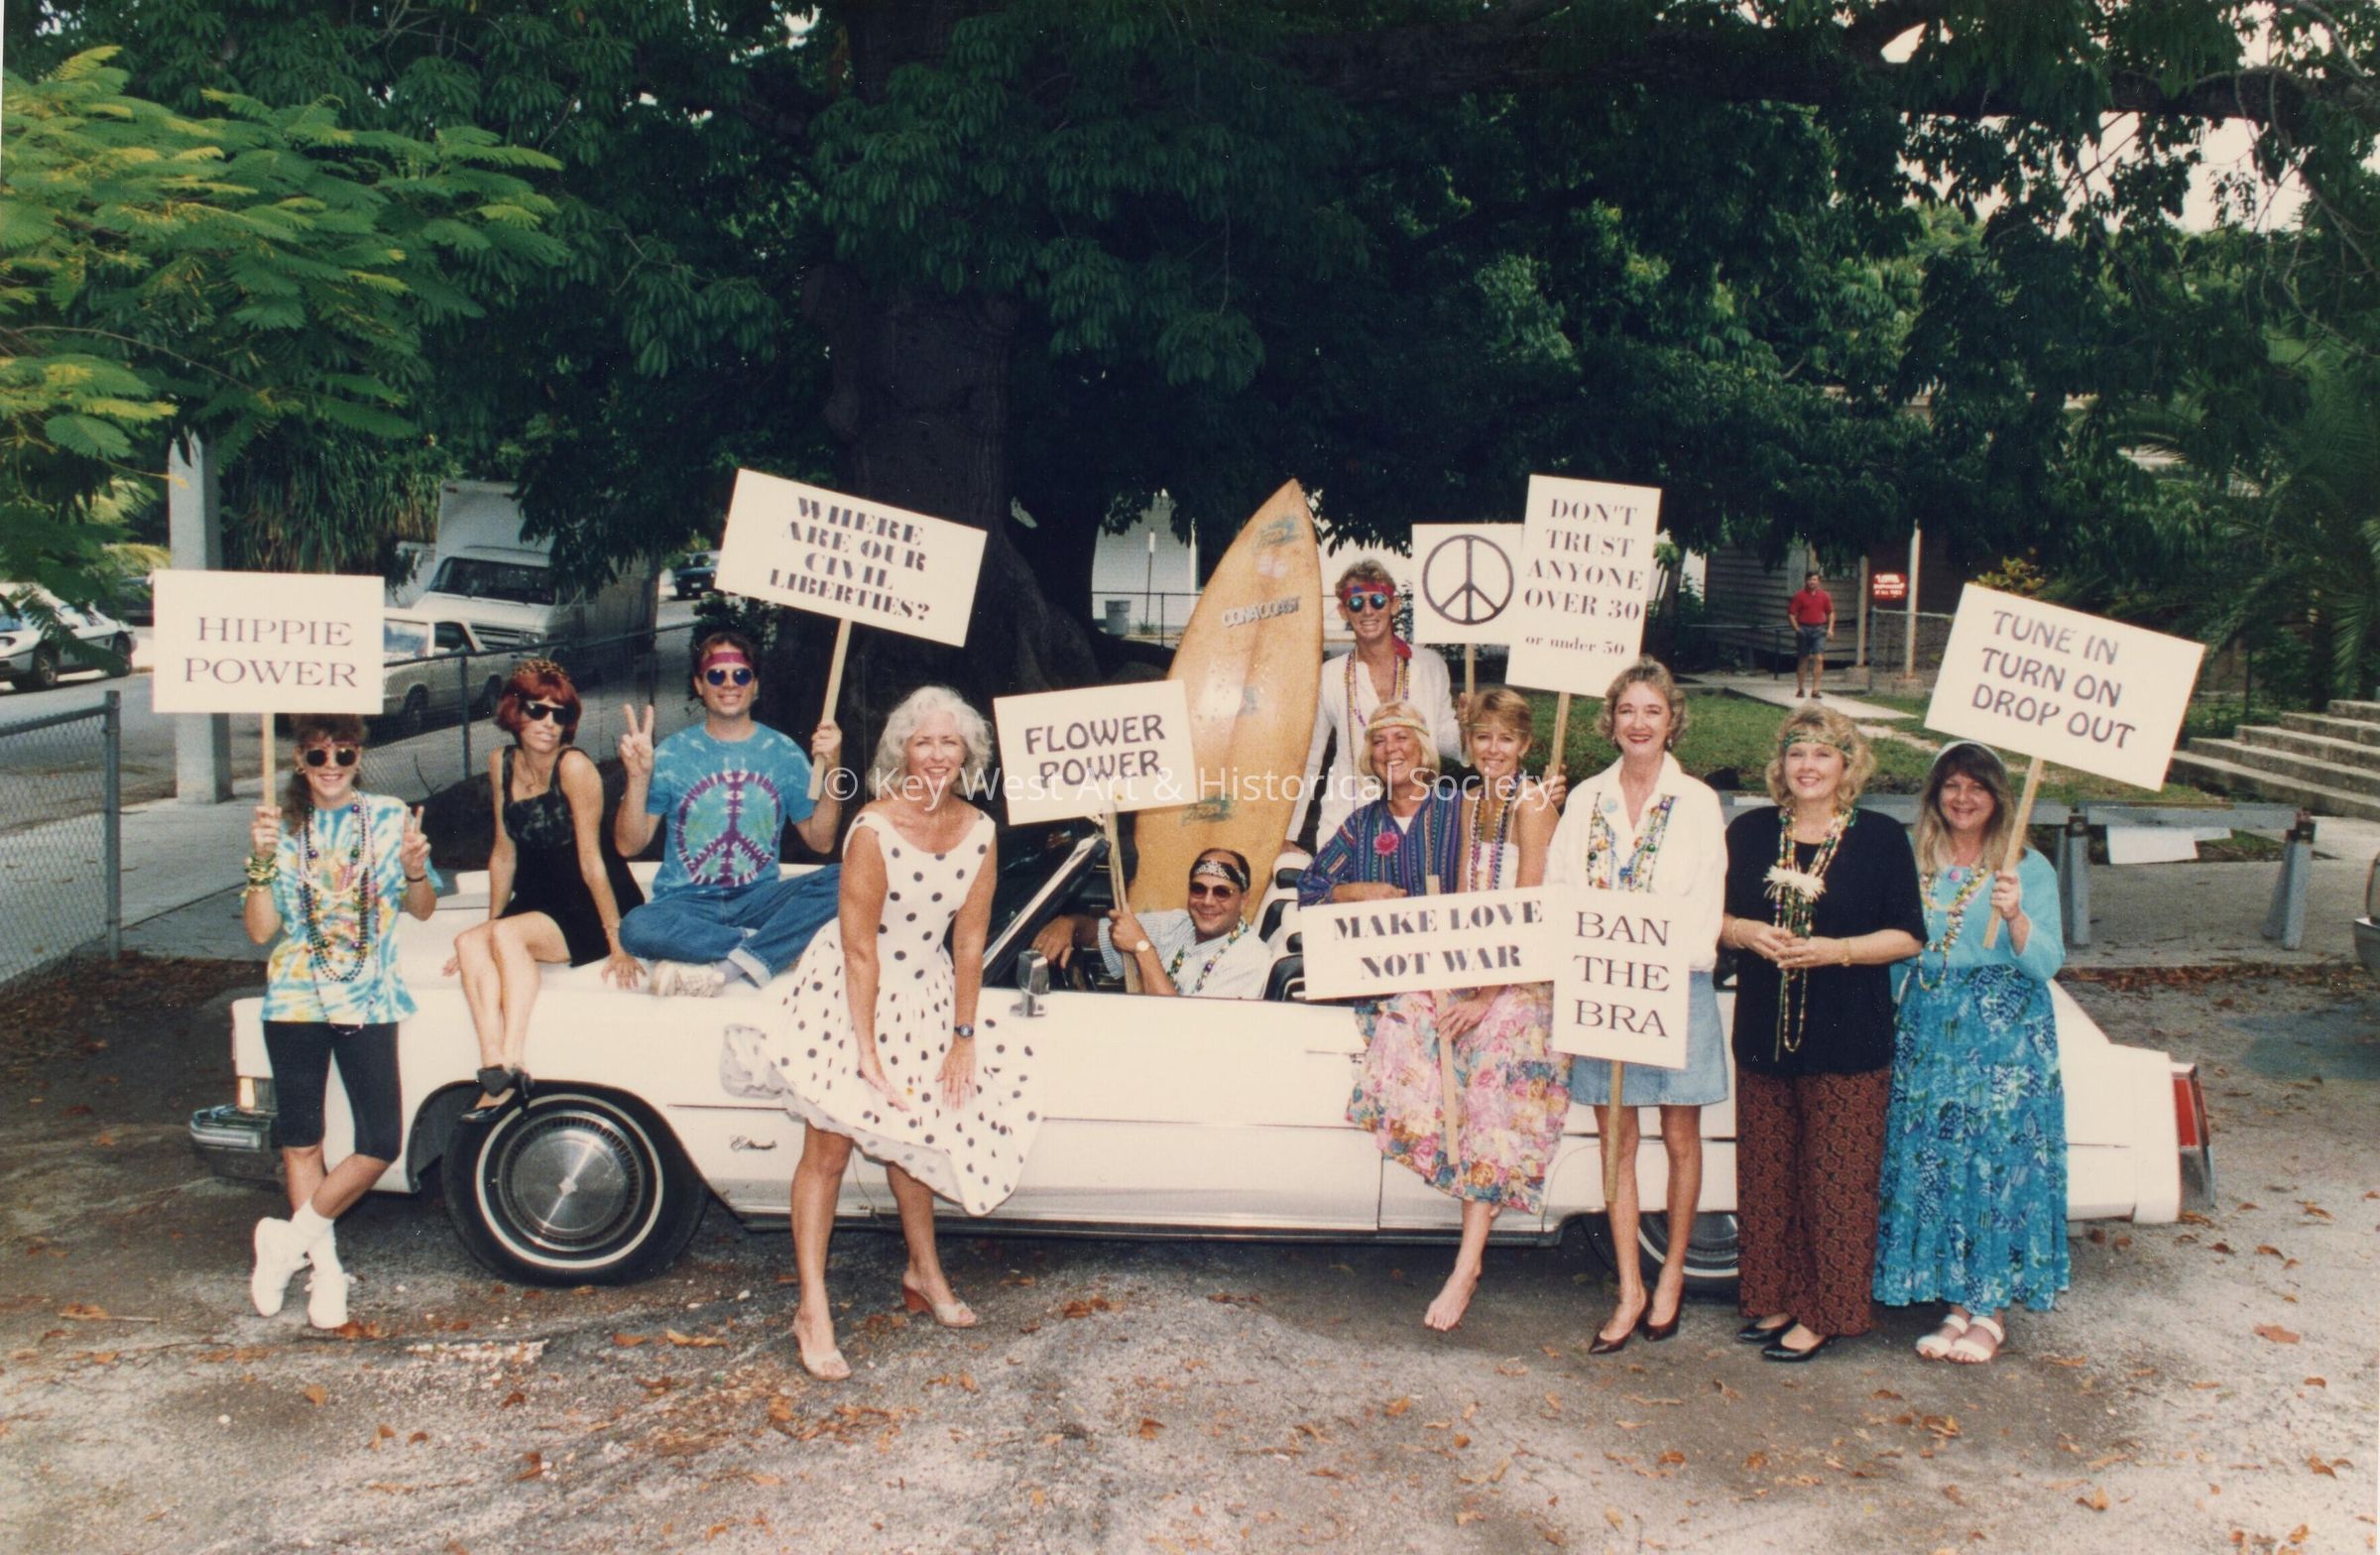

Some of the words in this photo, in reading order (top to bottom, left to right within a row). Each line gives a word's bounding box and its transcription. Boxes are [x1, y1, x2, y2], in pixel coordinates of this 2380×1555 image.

[798, 497, 923, 546] WHERE
[1551, 499, 1637, 527] DON'T
[781, 521, 851, 553] ARE
[860, 539, 926, 572] OUR
[1546, 529, 1634, 558] TRUST
[804, 552, 893, 590] CIVIL
[1527, 557, 1644, 592] ANYONE
[770, 568, 930, 621] LIBERTIES?
[1524, 587, 1597, 616] OVER
[1607, 599, 1640, 621] 30
[197, 616, 353, 647] HIPPIE
[1525, 635, 1543, 646] or
[1550, 636, 1597, 653] under
[1603, 642, 1624, 655] 50
[1993, 610, 2078, 655] TUNE
[2082, 635, 2119, 665] IN
[184, 658, 357, 687] POWER
[1981, 647, 2066, 692] TURN
[2073, 674, 2122, 708] ON
[1025, 714, 1165, 755] FLOWER
[1971, 683, 2061, 726] DROP
[2067, 711, 2136, 749] OUT
[1039, 750, 1160, 788] POWER
[1335, 908, 1437, 940] MAKE
[1450, 899, 1543, 930] LOVE
[1576, 910, 1671, 946] BAN
[1360, 951, 1430, 979] NOT
[1442, 944, 1521, 972] WAR
[1573, 955, 1670, 992] THE
[1573, 999, 1668, 1037] BRA
